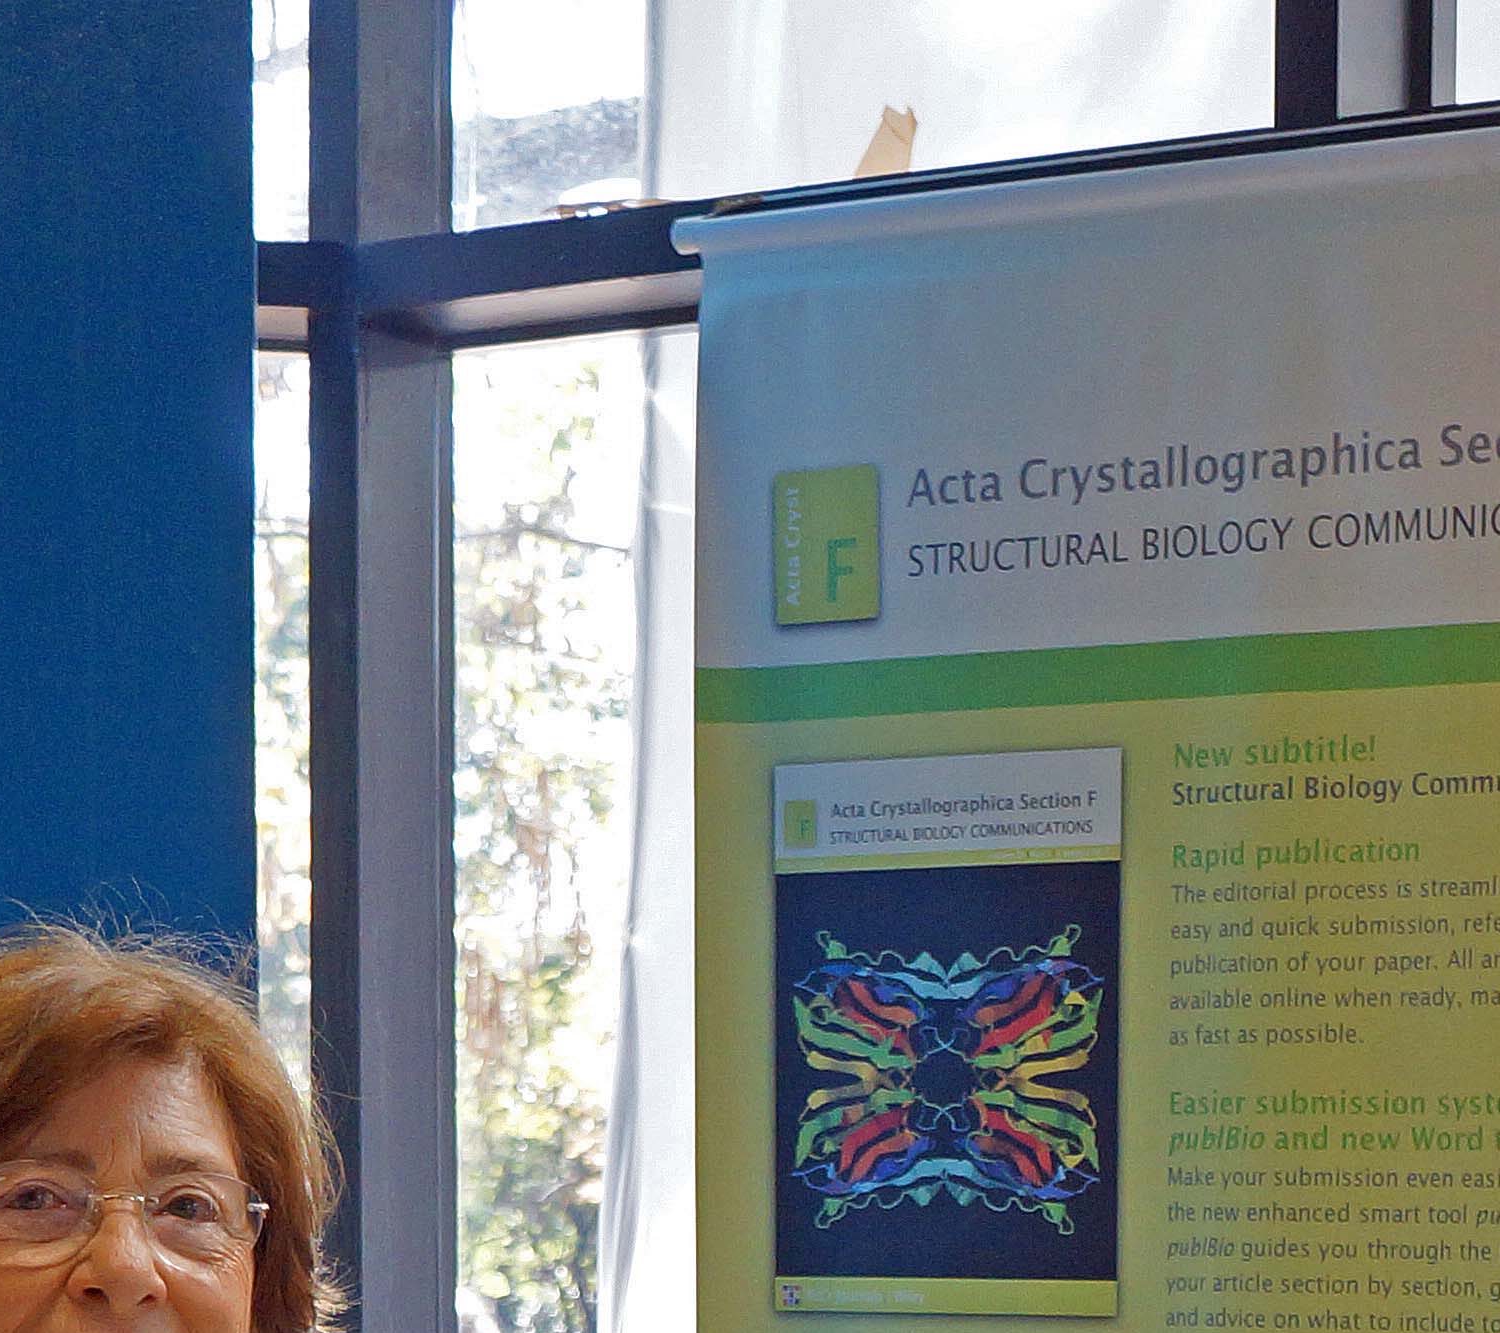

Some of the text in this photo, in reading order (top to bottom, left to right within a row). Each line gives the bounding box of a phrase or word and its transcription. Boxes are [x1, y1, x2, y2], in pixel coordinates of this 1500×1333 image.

[908, 468, 1002, 506] Acta
[1020, 431, 1422, 504] Crystallographica
[827, 537, 857, 603] F
[909, 531, 1128, 576] STRUCTURAL
[1143, 518, 1293, 559] BIOLOGY
[831, 790, 1097, 819] Acta Crystallographica Section F
[1173, 776, 1292, 805] Structural
[1305, 774, 1402, 803] Biology
